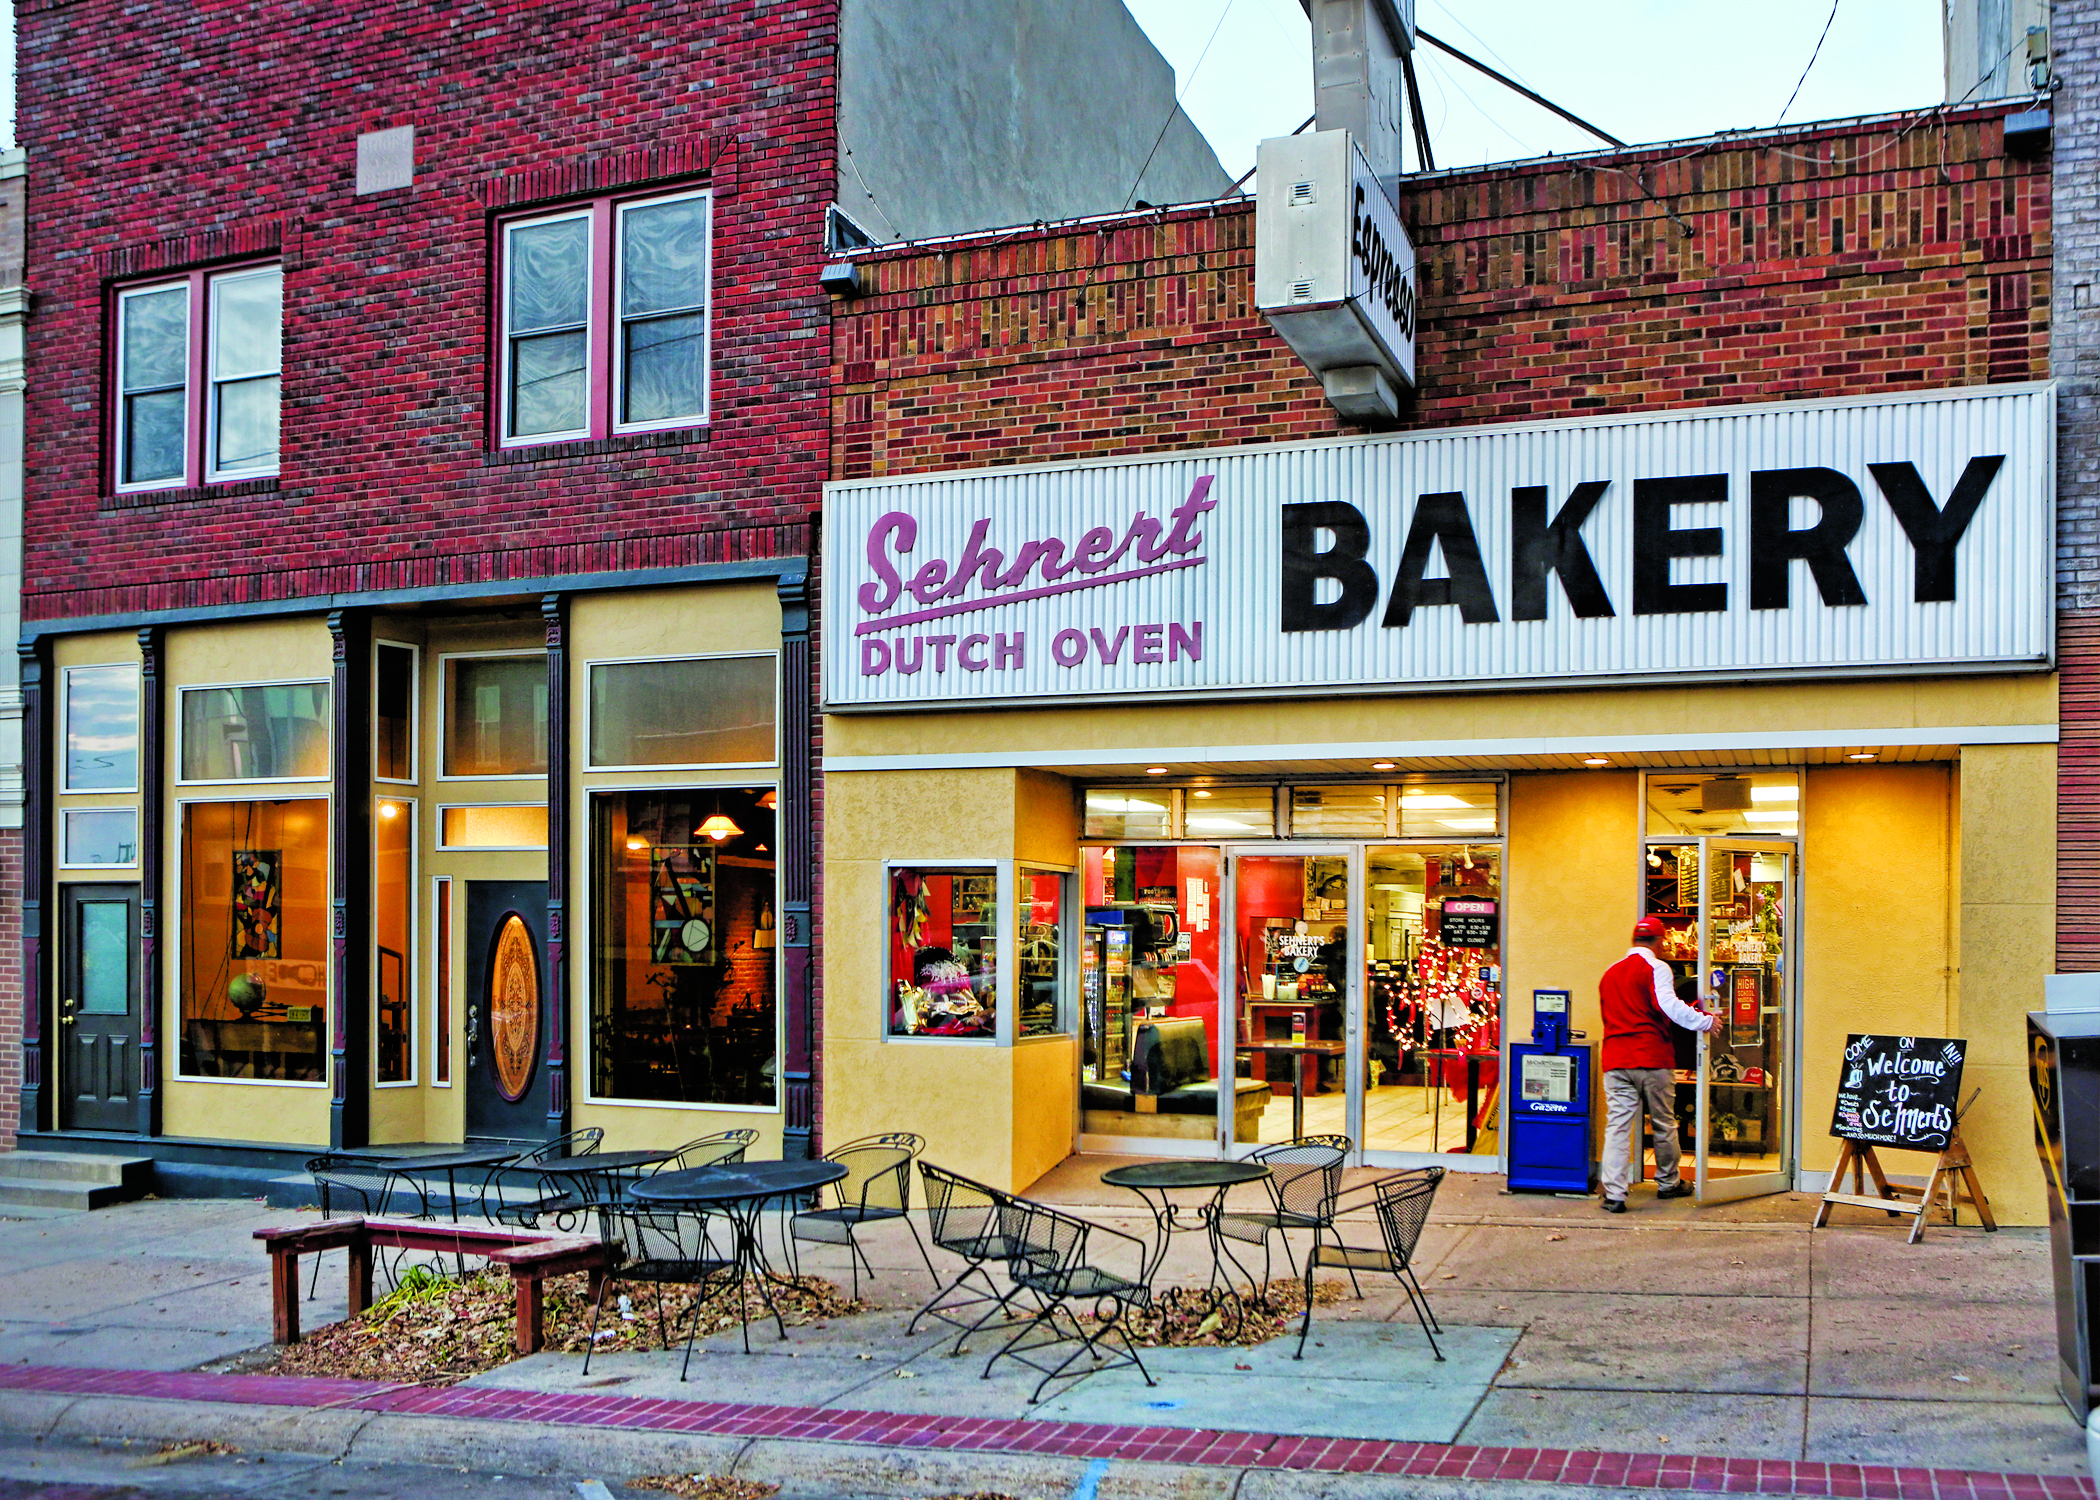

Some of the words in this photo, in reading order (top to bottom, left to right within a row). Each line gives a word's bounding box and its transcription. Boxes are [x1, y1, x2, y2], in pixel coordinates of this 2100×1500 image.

[1352, 181, 1415, 343] Espresso
[858, 475, 1217, 614] Sehnert
[1281, 454, 2007, 632] BAKERY
[861, 632, 1025, 676] DUTCH
[1051, 621, 1202, 668] OVEN
[1454, 902, 1485, 912] OPEN
[1279, 935, 1325, 947] SEHNERT'S
[1284, 946, 1319, 958] BAKERY
[1738, 952, 1763, 964] BAKERY
[1737, 978, 1755, 990] HIGH
[1844, 1034, 1874, 1061] COME
[1898, 1036, 1916, 1049] ON
[1943, 1042, 1963, 1066] IN!!
[1866, 1051, 1947, 1077] Welcome
[1884, 1080, 1910, 1102] to
[1530, 1102, 1568, 1113] Gazette
